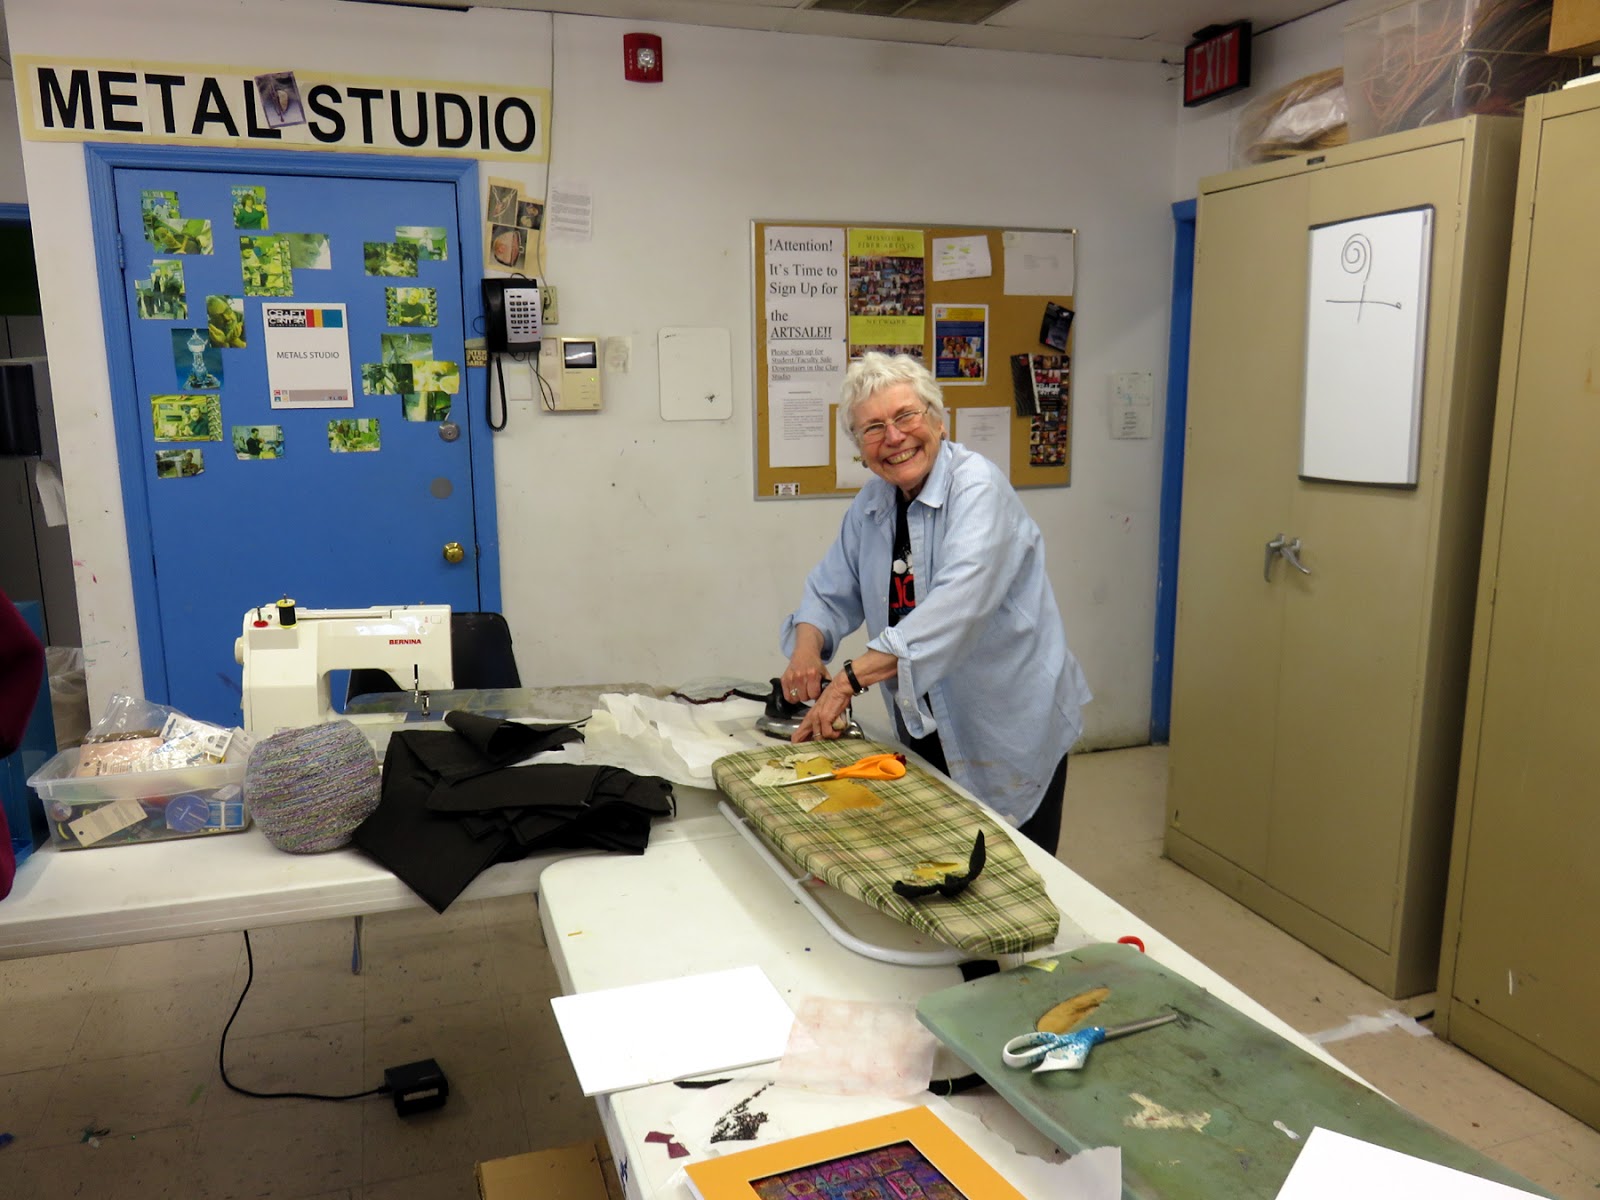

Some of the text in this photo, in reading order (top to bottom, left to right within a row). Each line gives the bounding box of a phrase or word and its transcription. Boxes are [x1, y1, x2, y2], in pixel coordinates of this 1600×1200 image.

[1192, 32, 1233, 96] EXIT
[37, 67, 536, 152] METAL STUDIO
[769, 238, 833, 252] !Attention!
[792, 263, 823, 276] Time
[826, 266, 838, 277] to
[769, 281, 838, 297] Sign Up for
[268, 309, 304, 317] CRAFT
[770, 309, 789, 321] the
[309, 351, 340, 359] STUDIO
